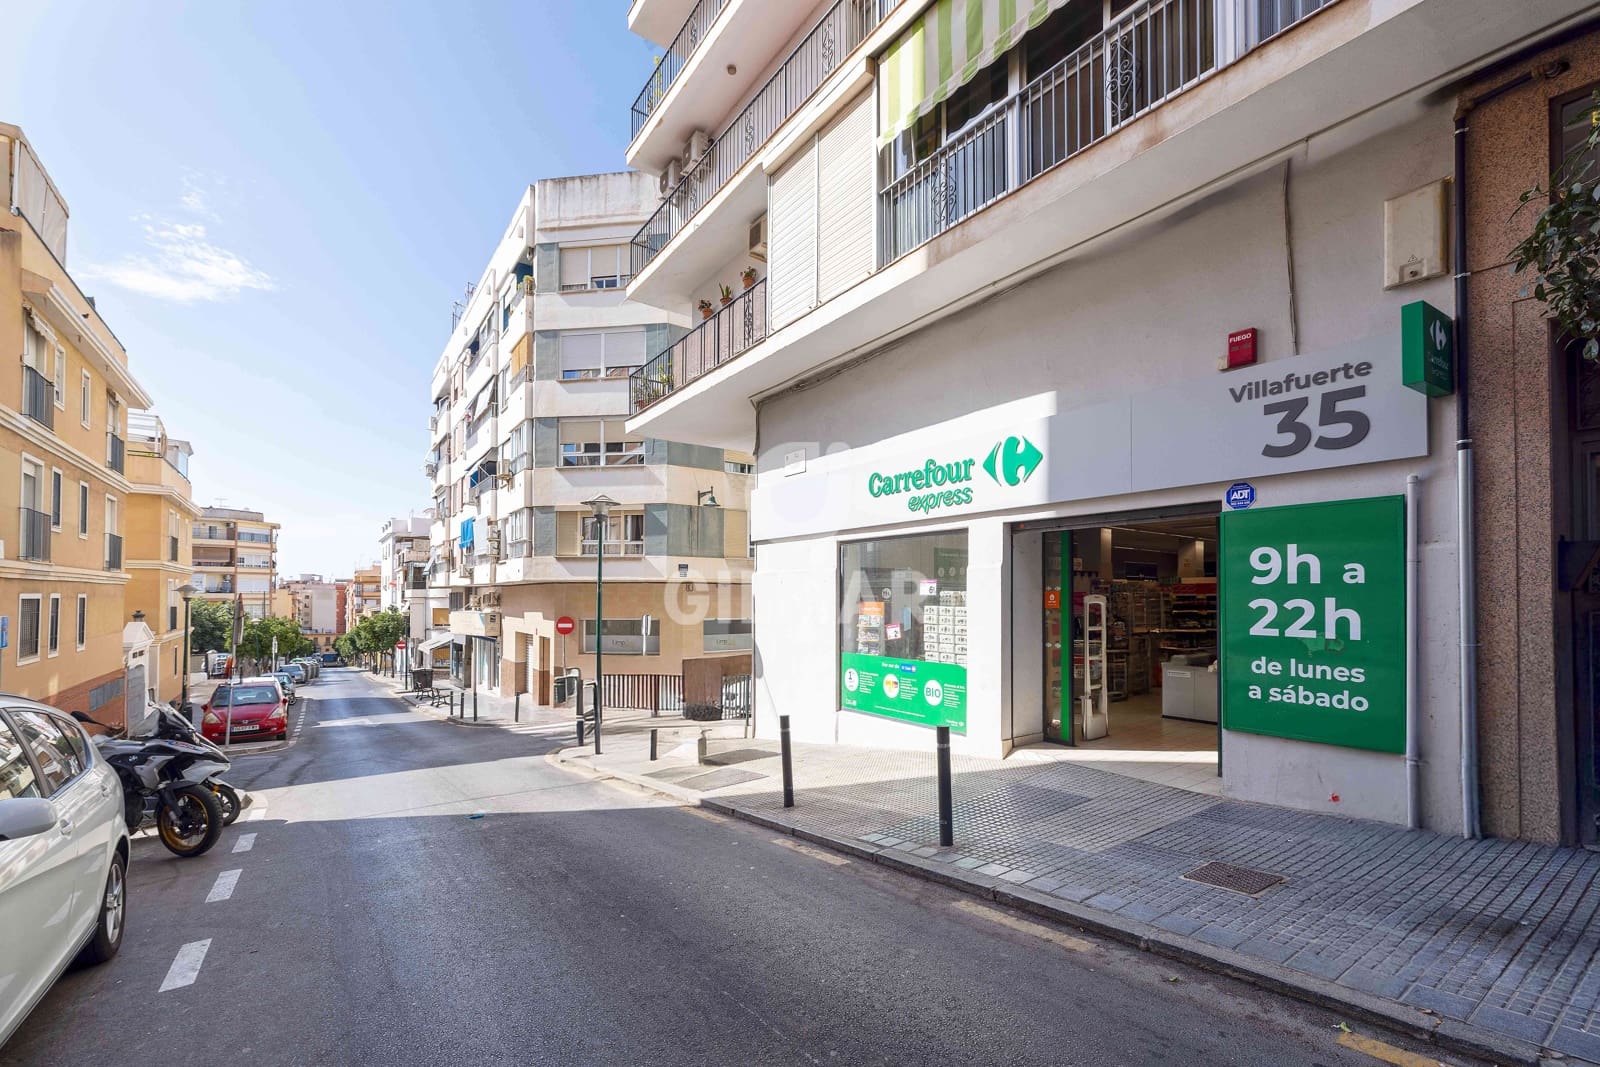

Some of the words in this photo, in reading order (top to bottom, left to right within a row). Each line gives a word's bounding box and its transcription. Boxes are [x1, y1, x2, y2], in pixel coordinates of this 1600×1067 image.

[1229, 333, 1252, 343] FUEGO
[1229, 361, 1373, 403] Villafuerte
[1261, 385, 1370, 458] 35
[868, 459, 975, 497] Carrefour
[908, 487, 974, 513] express
[1231, 490, 1250, 500] ADT
[1249, 543, 1321, 585] 9h
[1343, 562, 1366, 584] a
[1248, 596, 1362, 641] 22h
[1251, 656, 1282, 675] de
[1290, 658, 1366, 683] lunes
[925, 688, 941, 698] BIO
[1248, 686, 1262, 700] a
[1269, 684, 1369, 712] sábado
